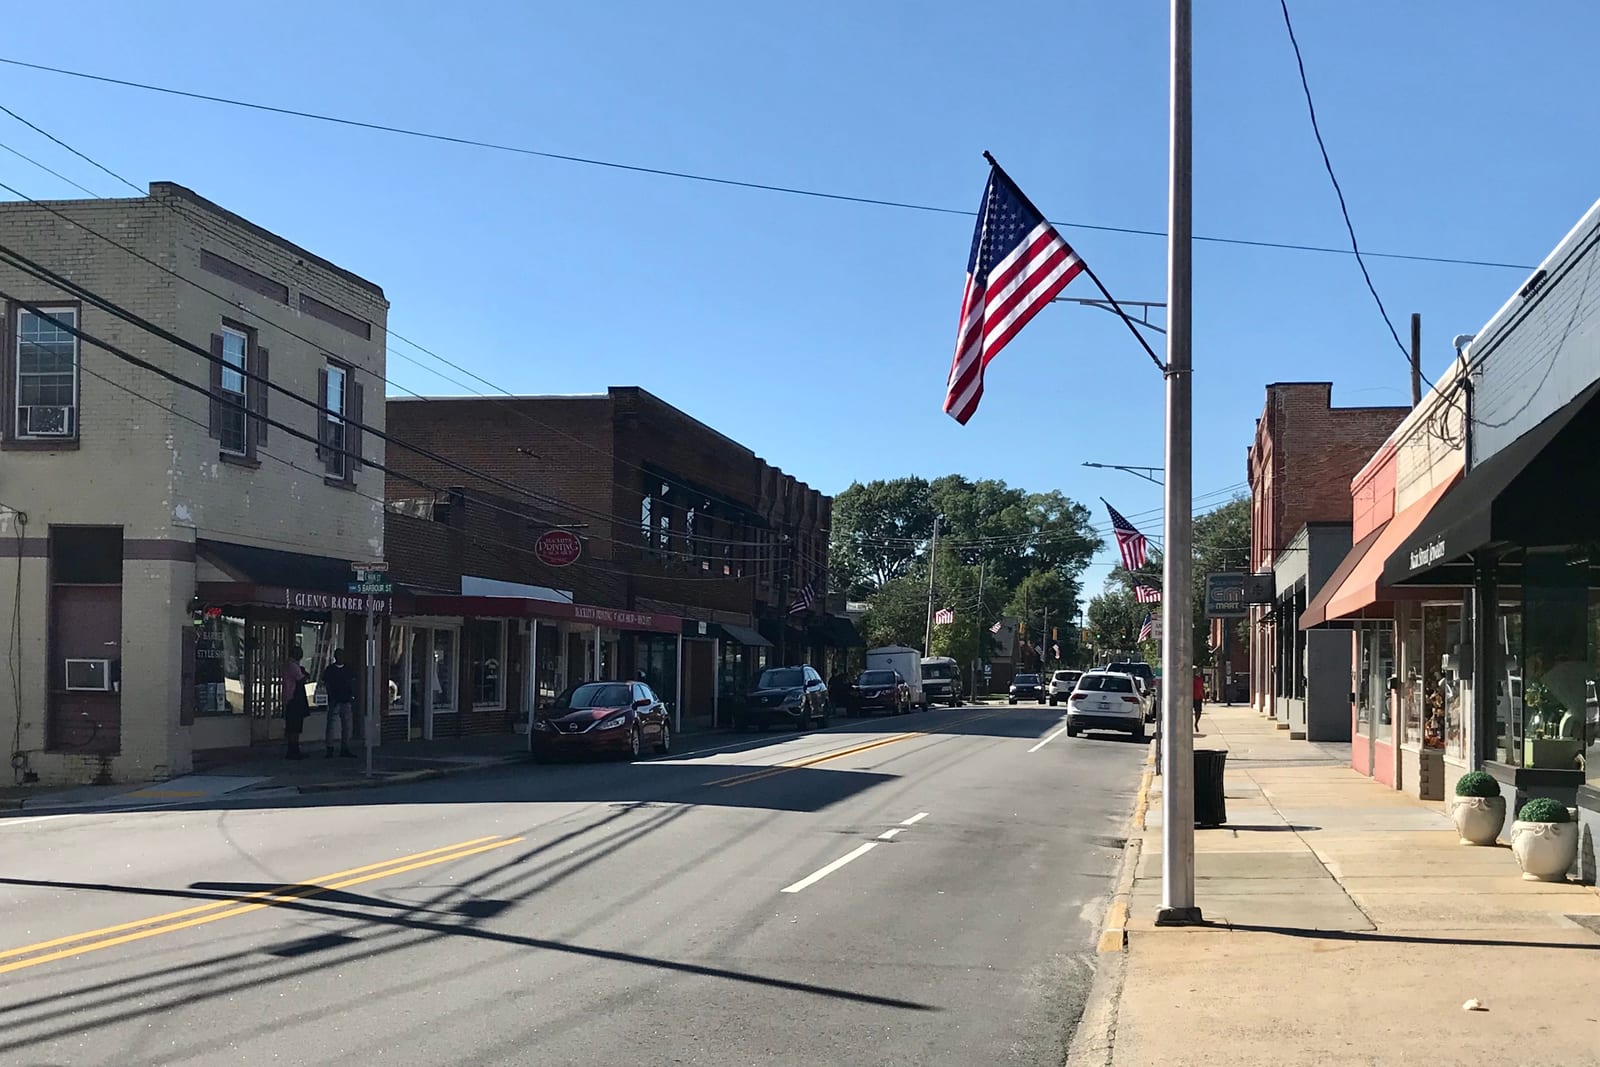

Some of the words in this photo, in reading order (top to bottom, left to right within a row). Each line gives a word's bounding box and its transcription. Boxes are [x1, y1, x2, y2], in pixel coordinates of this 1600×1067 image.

[539, 541, 578, 551] PRINTING
[362, 584, 384, 592] BARBOUR
[385, 584, 392, 592] ST
[295, 592, 327, 608] GLEN'S
[331, 596, 362, 611] BARBER
